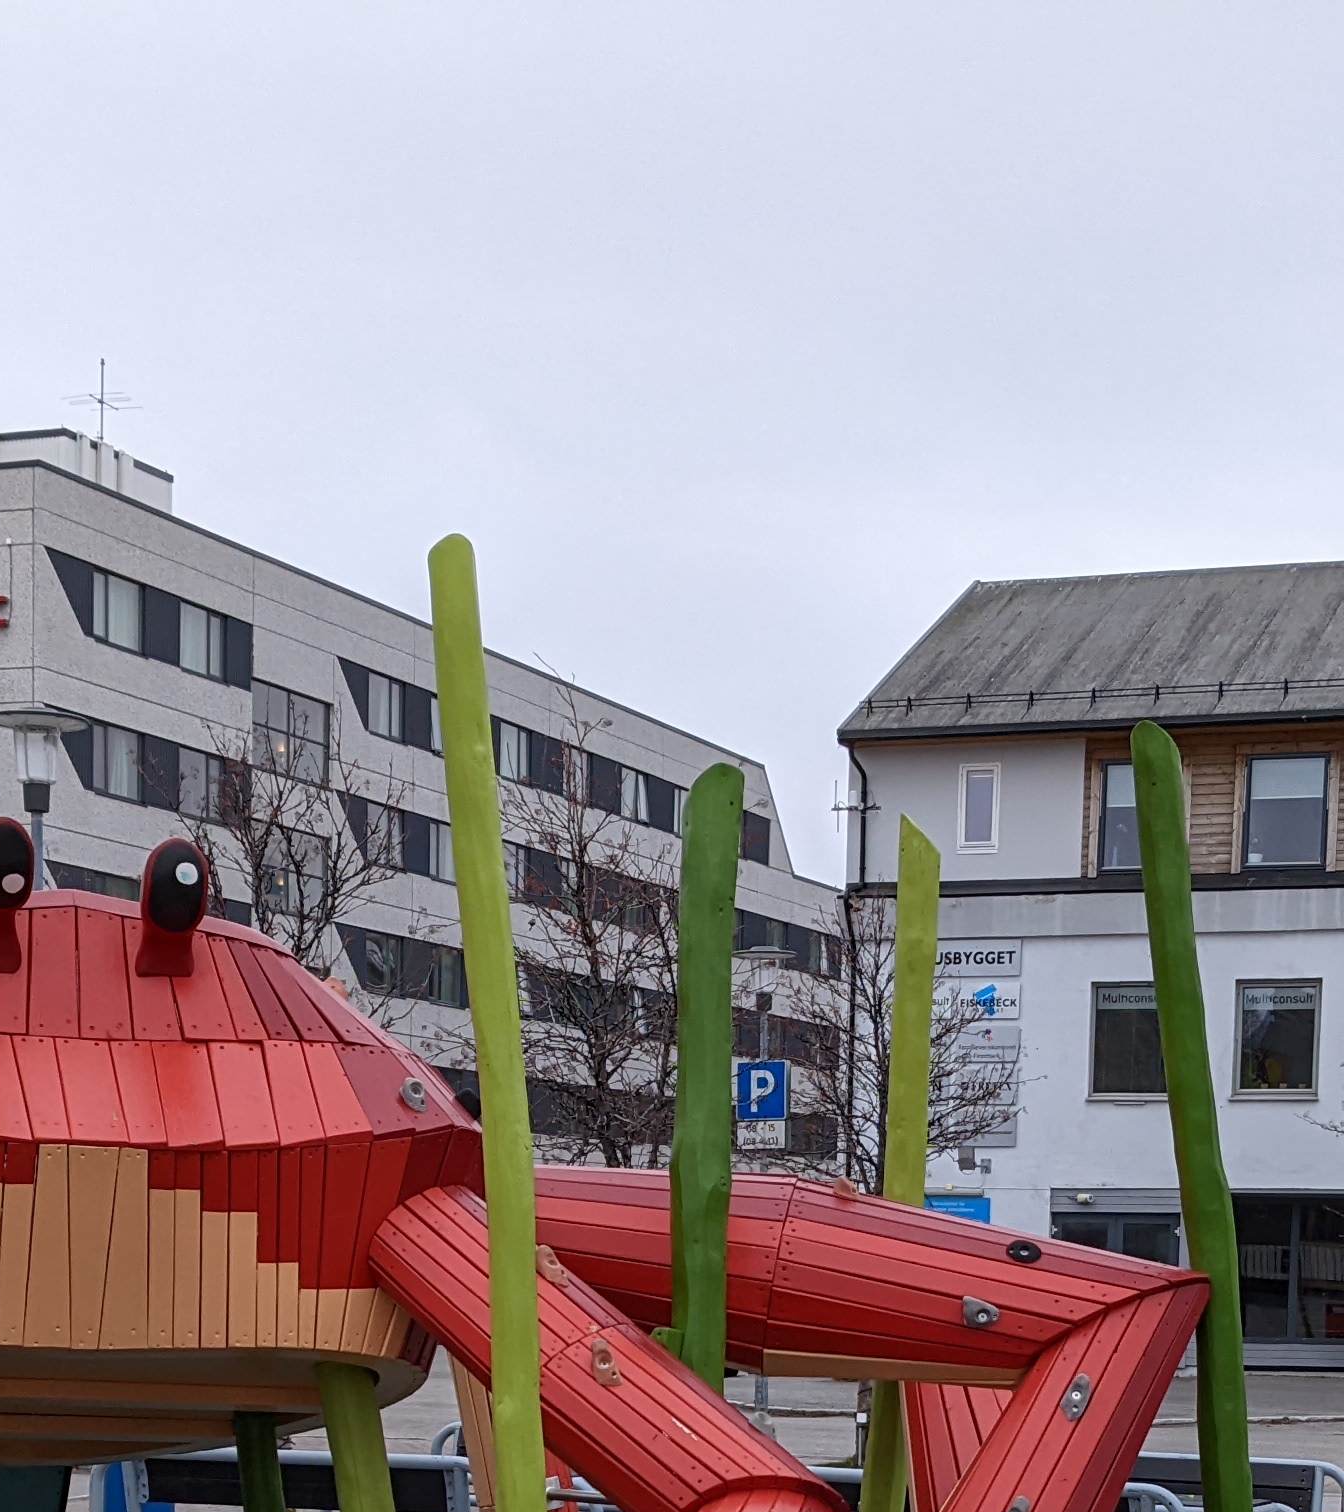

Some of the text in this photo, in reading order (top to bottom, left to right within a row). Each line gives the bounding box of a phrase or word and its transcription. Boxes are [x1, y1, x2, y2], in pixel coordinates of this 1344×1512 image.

[935, 950, 1016, 966] USBYGGET
[1102, 992, 1155, 1004] Multicons
[1245, 992, 1314, 1004] Multiconsult
[750, 1069, 775, 1113] P
